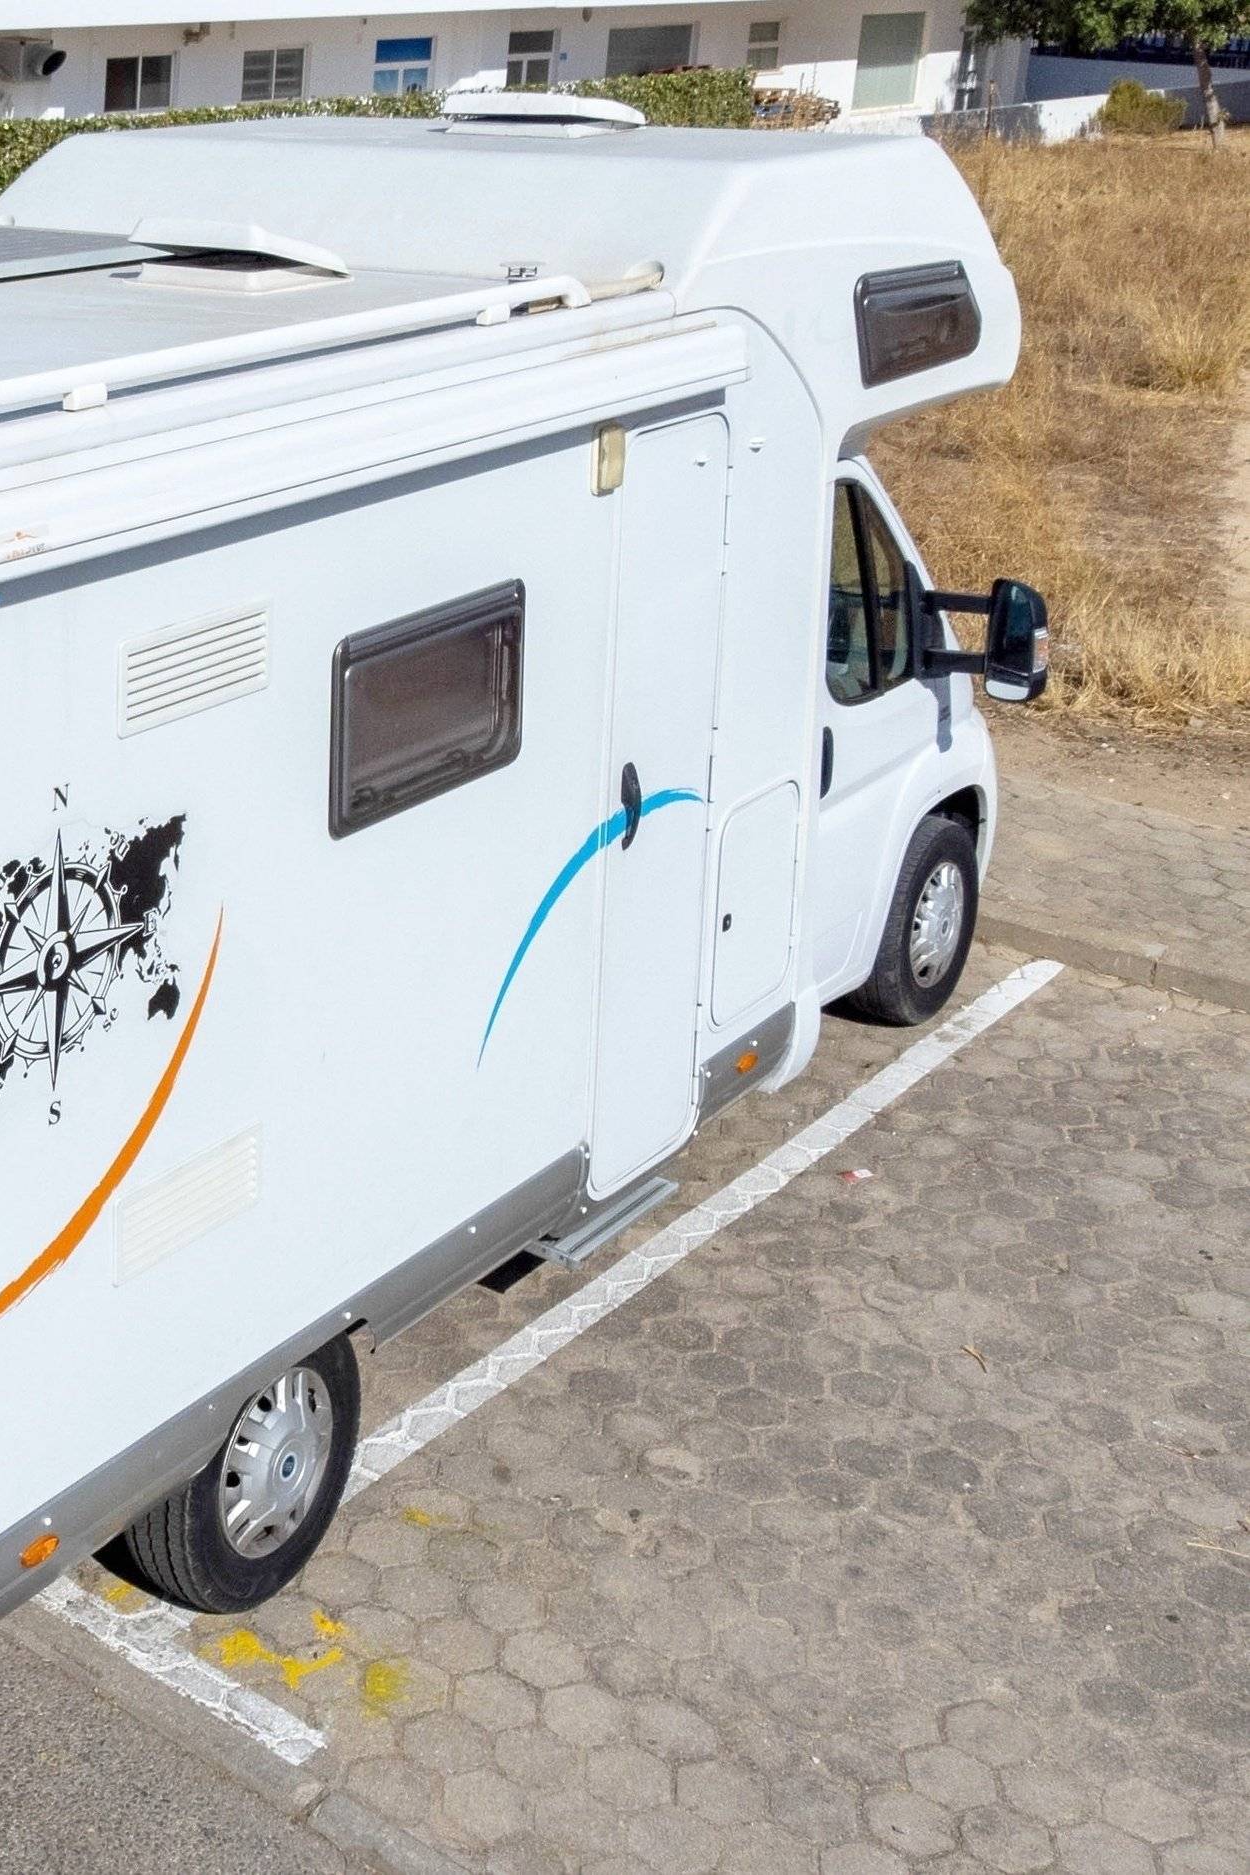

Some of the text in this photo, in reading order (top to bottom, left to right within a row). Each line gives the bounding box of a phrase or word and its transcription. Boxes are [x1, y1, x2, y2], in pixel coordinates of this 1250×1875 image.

[52, 783, 70, 811] N
[143, 908, 158, 936] E
[48, 1101, 61, 1125] S
